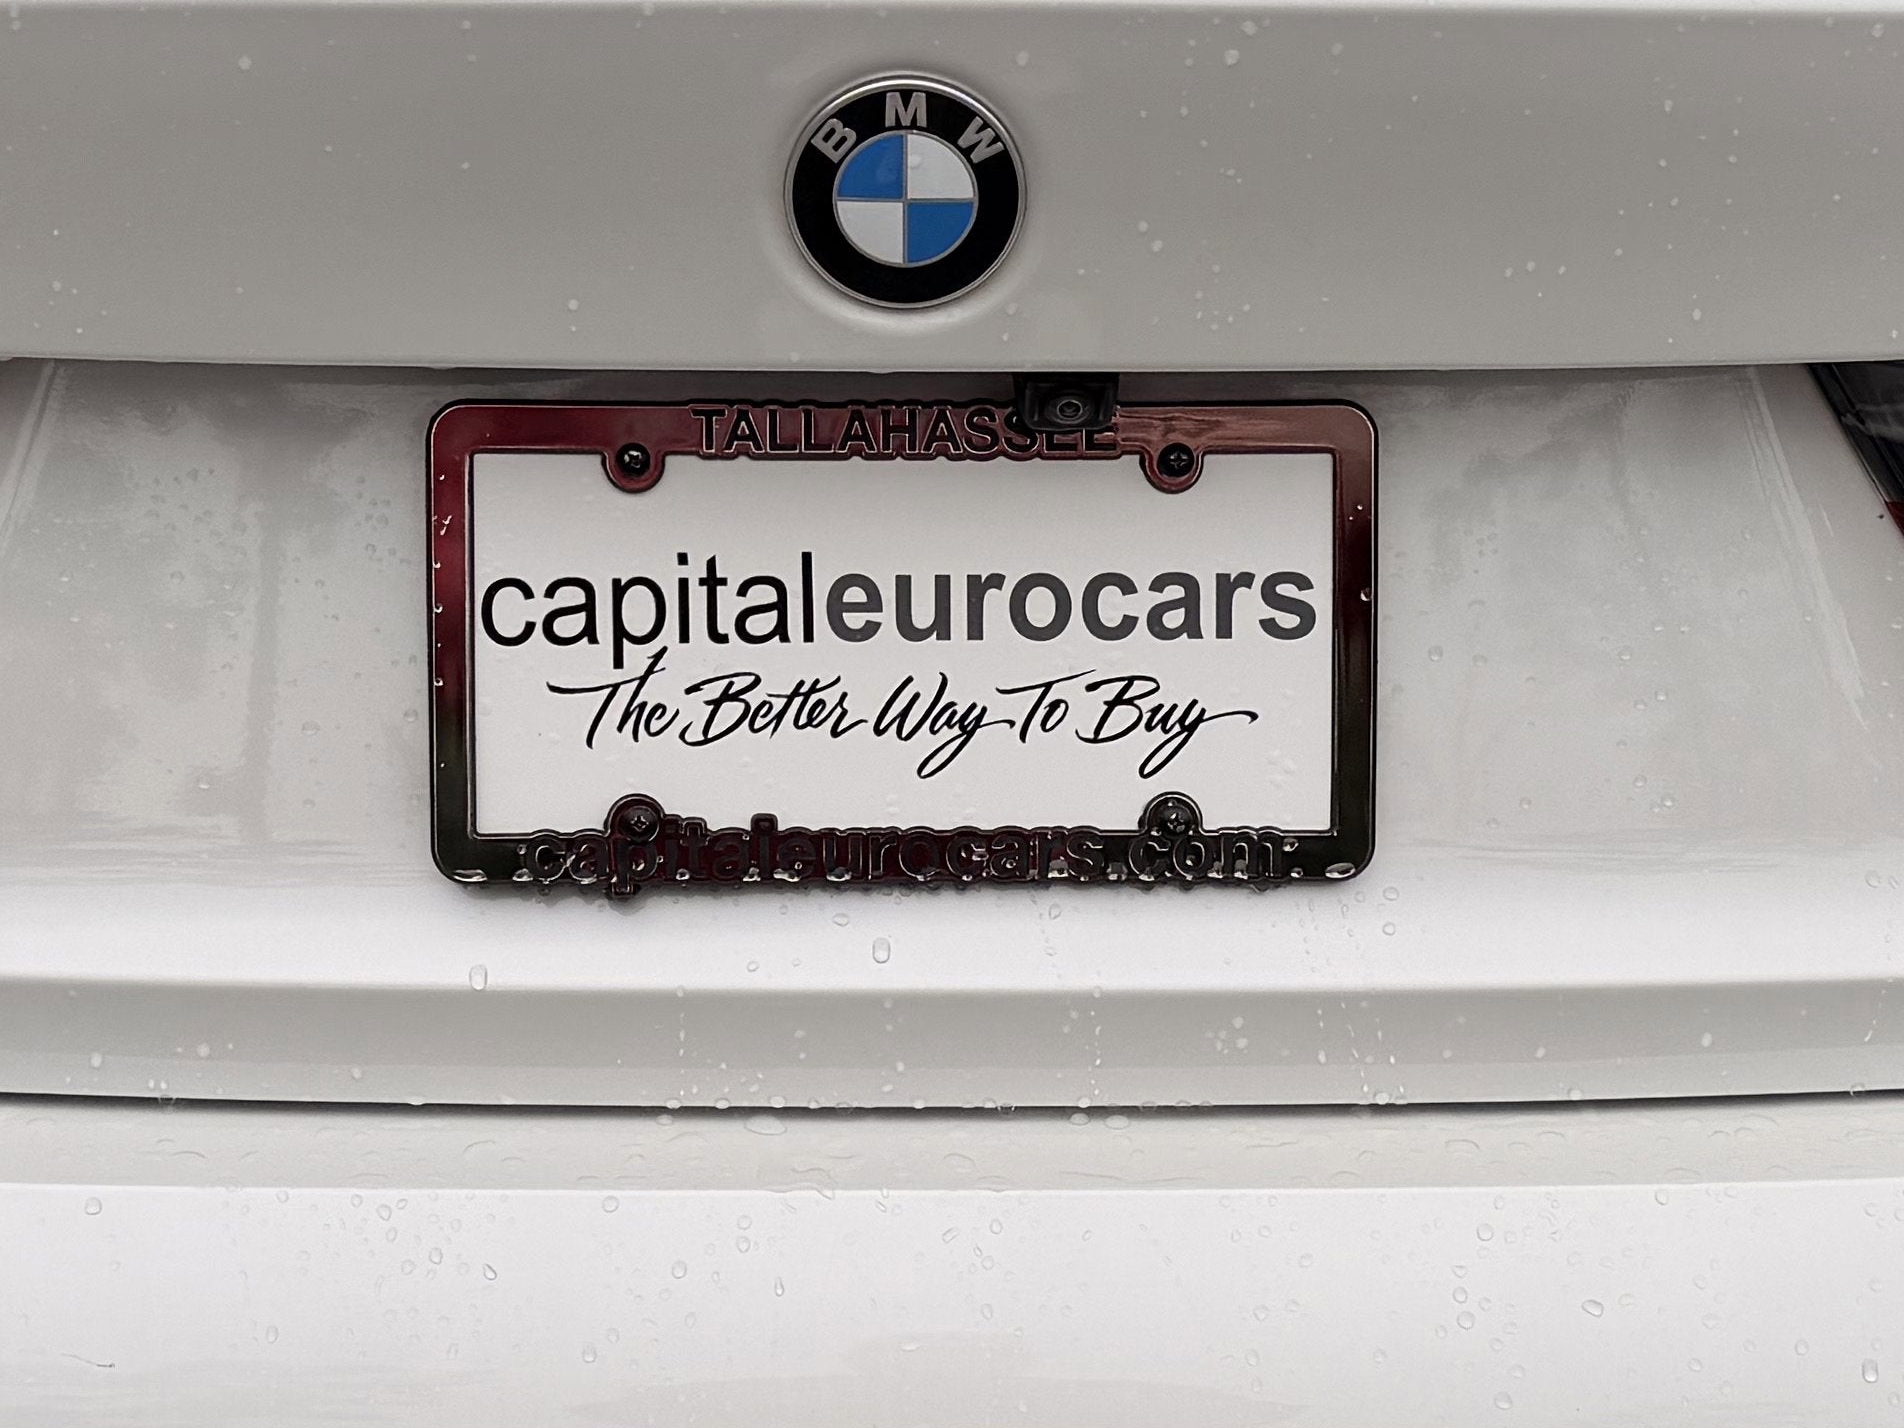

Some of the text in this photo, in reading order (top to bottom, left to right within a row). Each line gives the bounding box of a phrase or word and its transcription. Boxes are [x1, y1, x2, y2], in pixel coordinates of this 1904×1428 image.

[810, 91, 1005, 164] BMW
[479, 551, 1318, 669] capitaleurocars
[546, 646, 1258, 779] The Better Way To Buy
